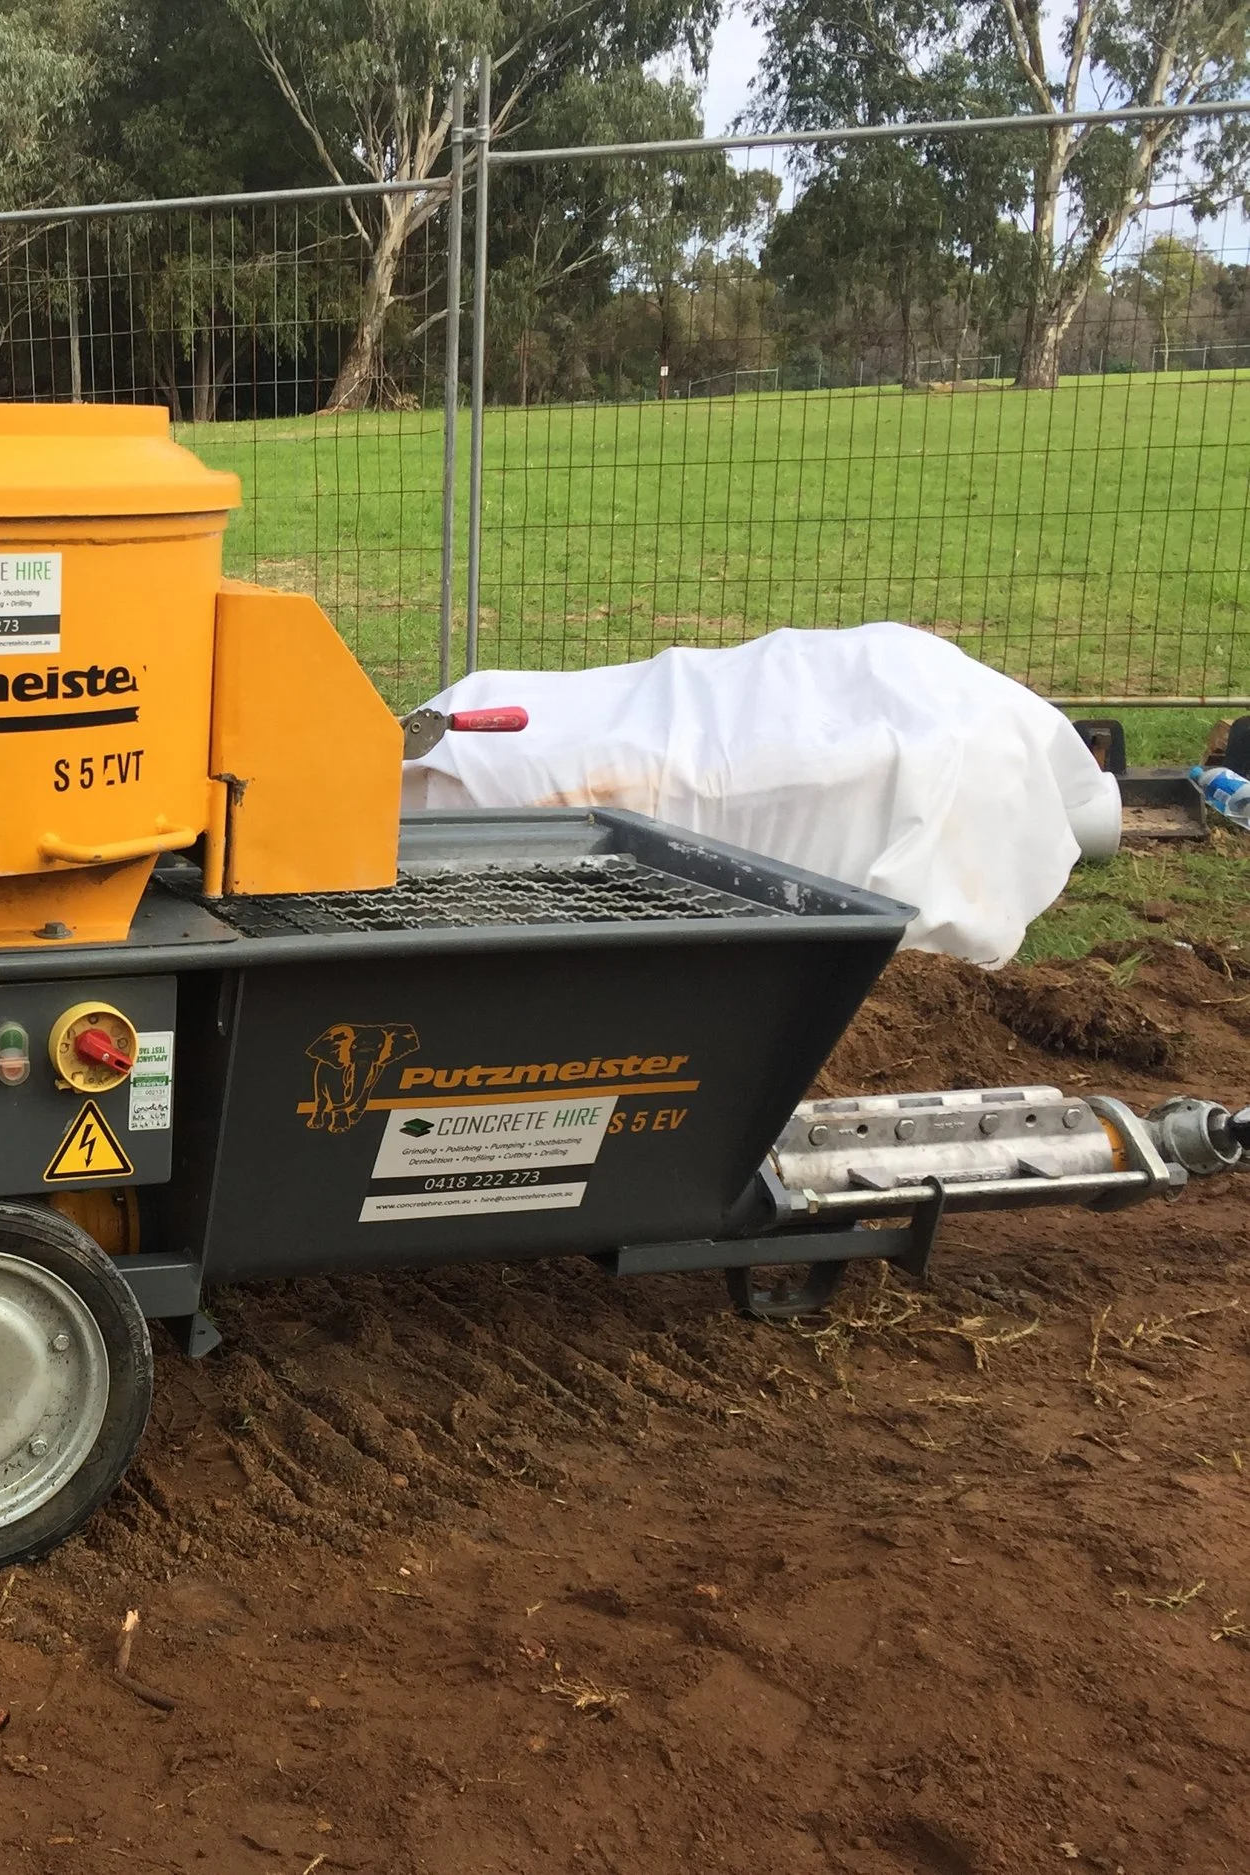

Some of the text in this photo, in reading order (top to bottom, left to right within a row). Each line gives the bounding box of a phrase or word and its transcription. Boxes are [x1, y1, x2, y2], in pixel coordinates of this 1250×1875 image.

[15, 561, 52, 581] HIRE
[3, 588, 40, 597] Shotblasting
[10, 599, 33, 608] Drilling
[53, 758, 70, 792] S
[79, 757, 94, 789] 5
[137, 1054, 168, 1063] APPLIANC
[399, 1055, 690, 1089] Putzmeister
[437, 1107, 603, 1136] CONCRETE HIRE
[608, 1108, 688, 1134] S 5 EV
[401, 1136, 582, 1156] Grinding Polishing Pumping Shotblasting
[408, 1148, 569, 1166] Demolition Profiling Cutting Drilling
[424, 1171, 541, 1190] 0418 222 273
[375, 1198, 472, 1211] www.concretehire.com.au
